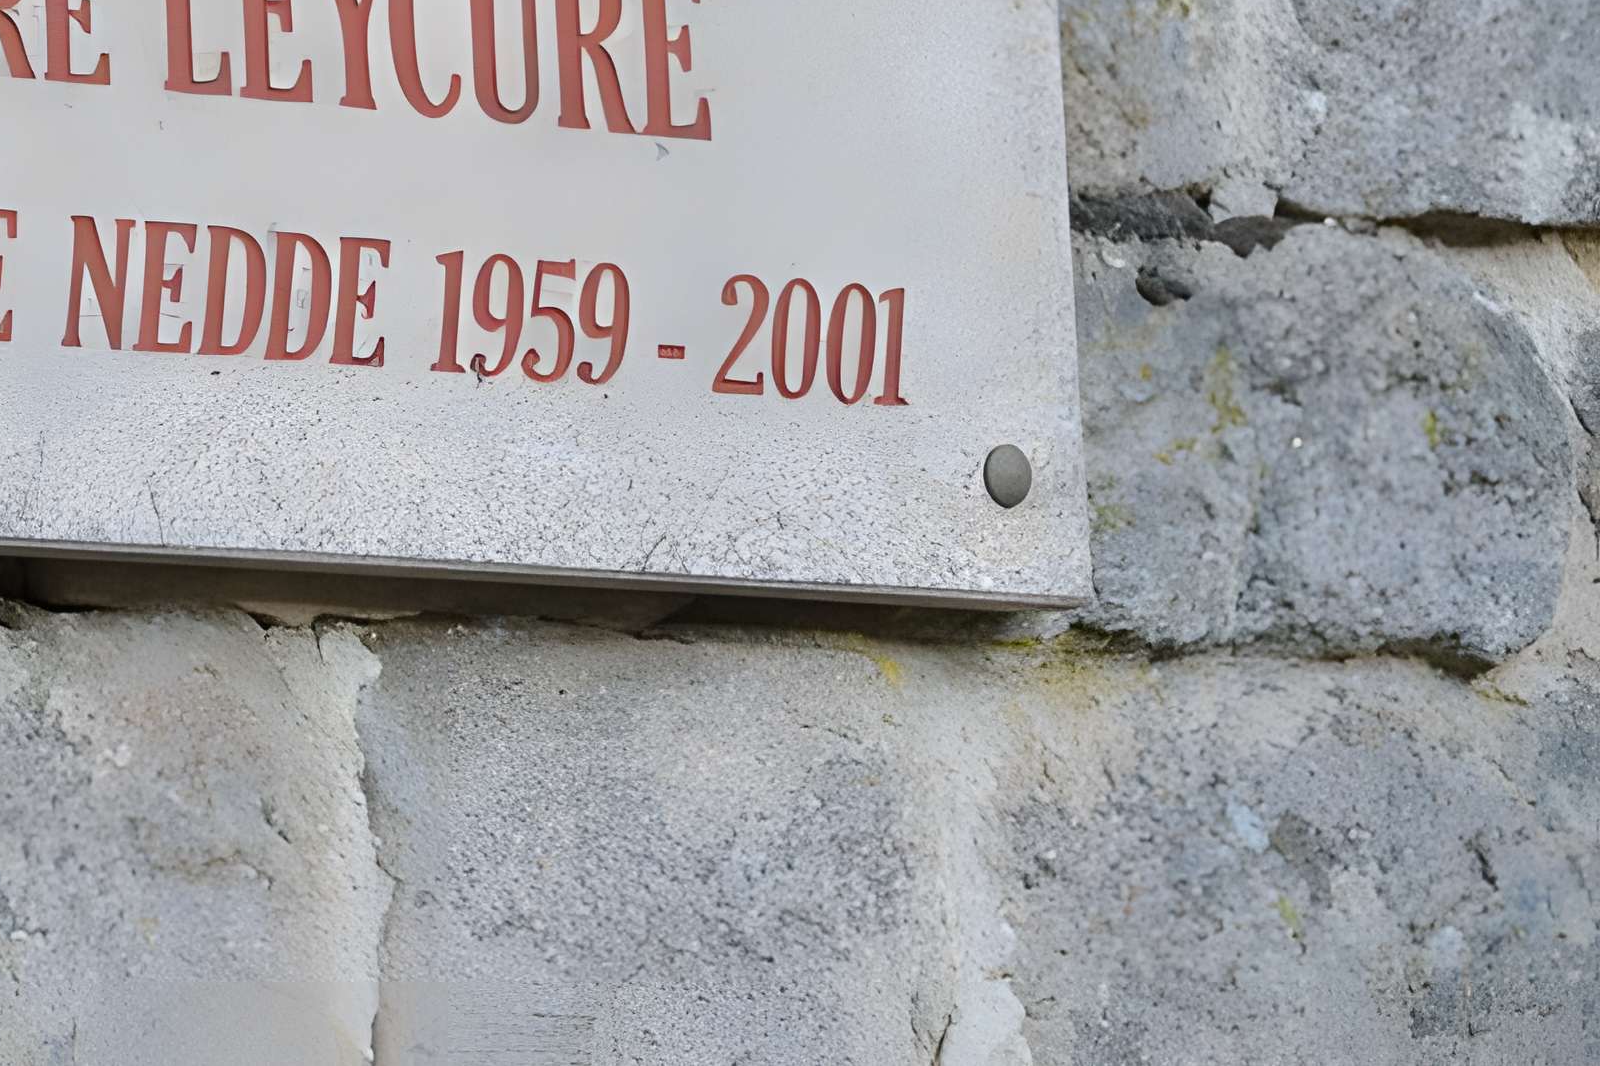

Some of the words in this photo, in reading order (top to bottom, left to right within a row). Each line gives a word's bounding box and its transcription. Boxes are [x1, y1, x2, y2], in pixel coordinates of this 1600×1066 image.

[63, 215, 391, 367] NEDDE
[431, 250, 630, 385] 1959
[711, 274, 906, 406] 2001
